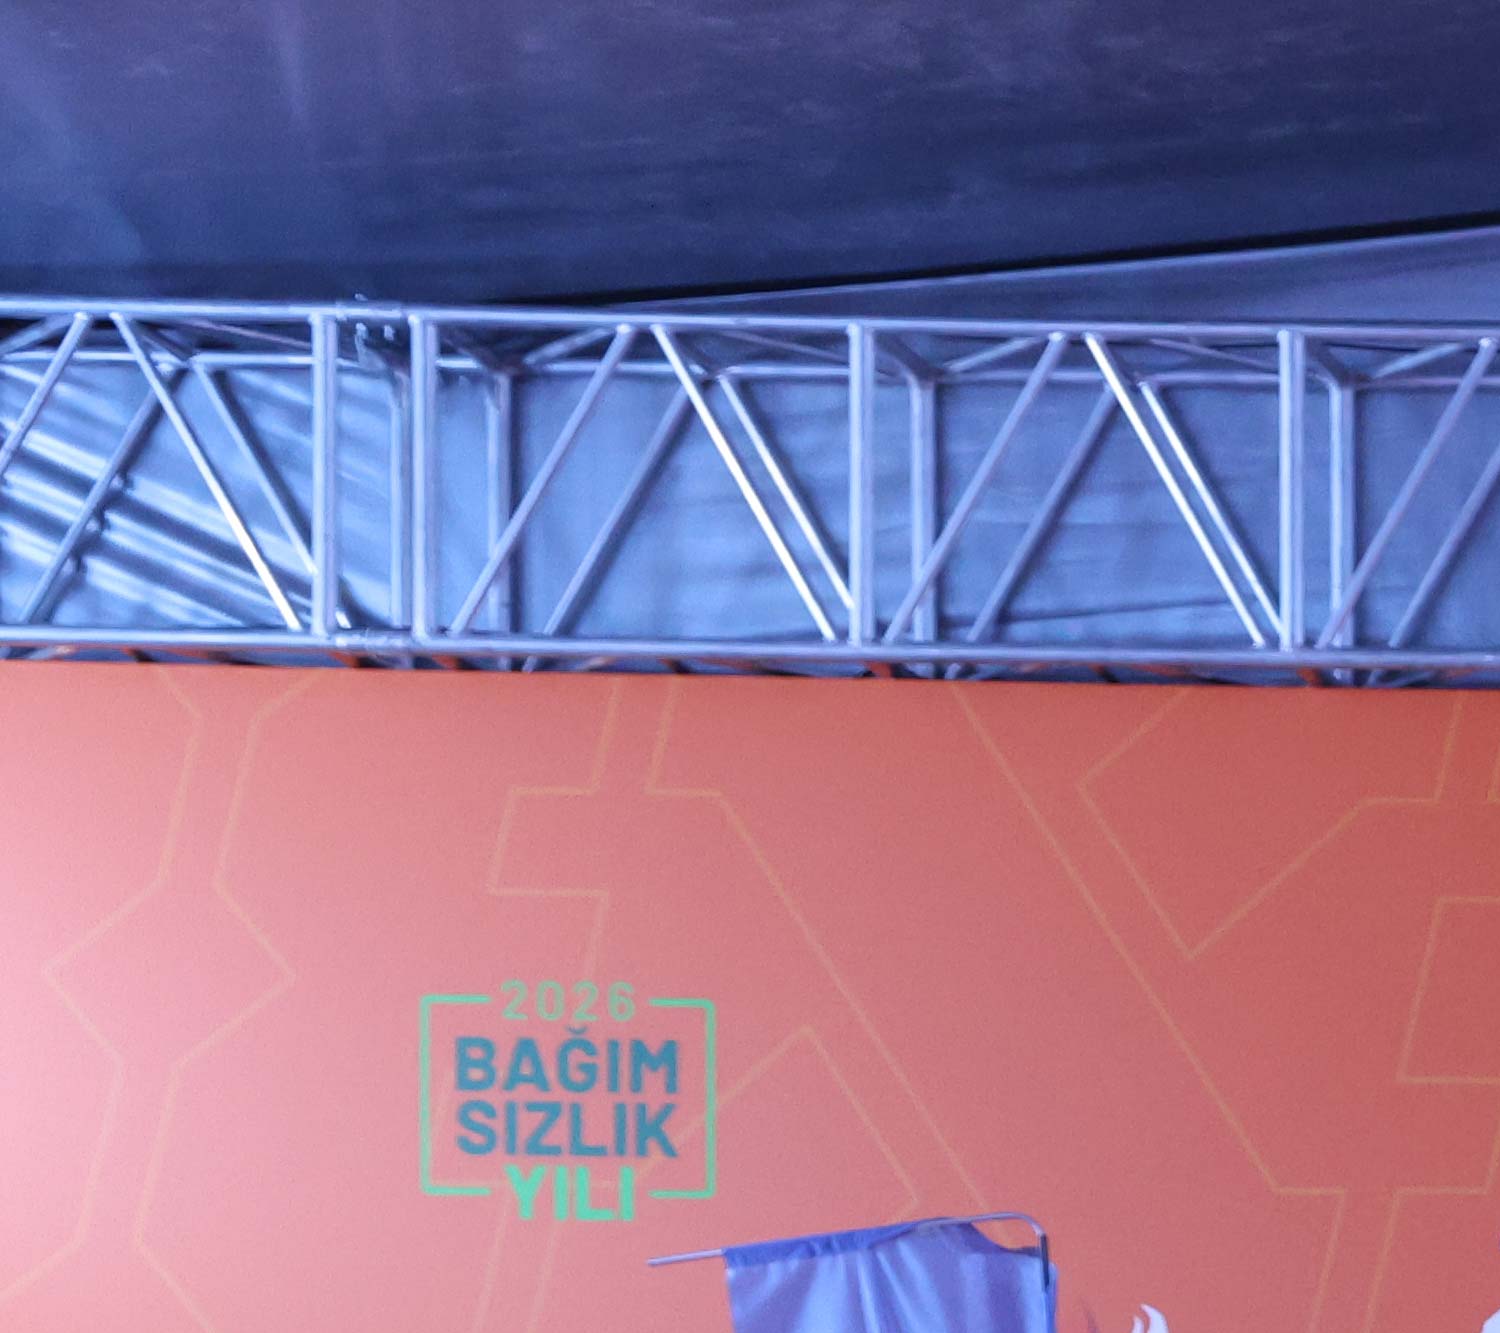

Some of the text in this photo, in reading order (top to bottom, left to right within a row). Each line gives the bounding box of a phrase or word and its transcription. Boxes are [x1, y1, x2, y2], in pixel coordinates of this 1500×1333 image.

[501, 980, 638, 1021] 2026
[455, 1026, 680, 1094] BAĞIM
[456, 1100, 679, 1158] SIZLIK
[502, 1165, 635, 1222] YILI
